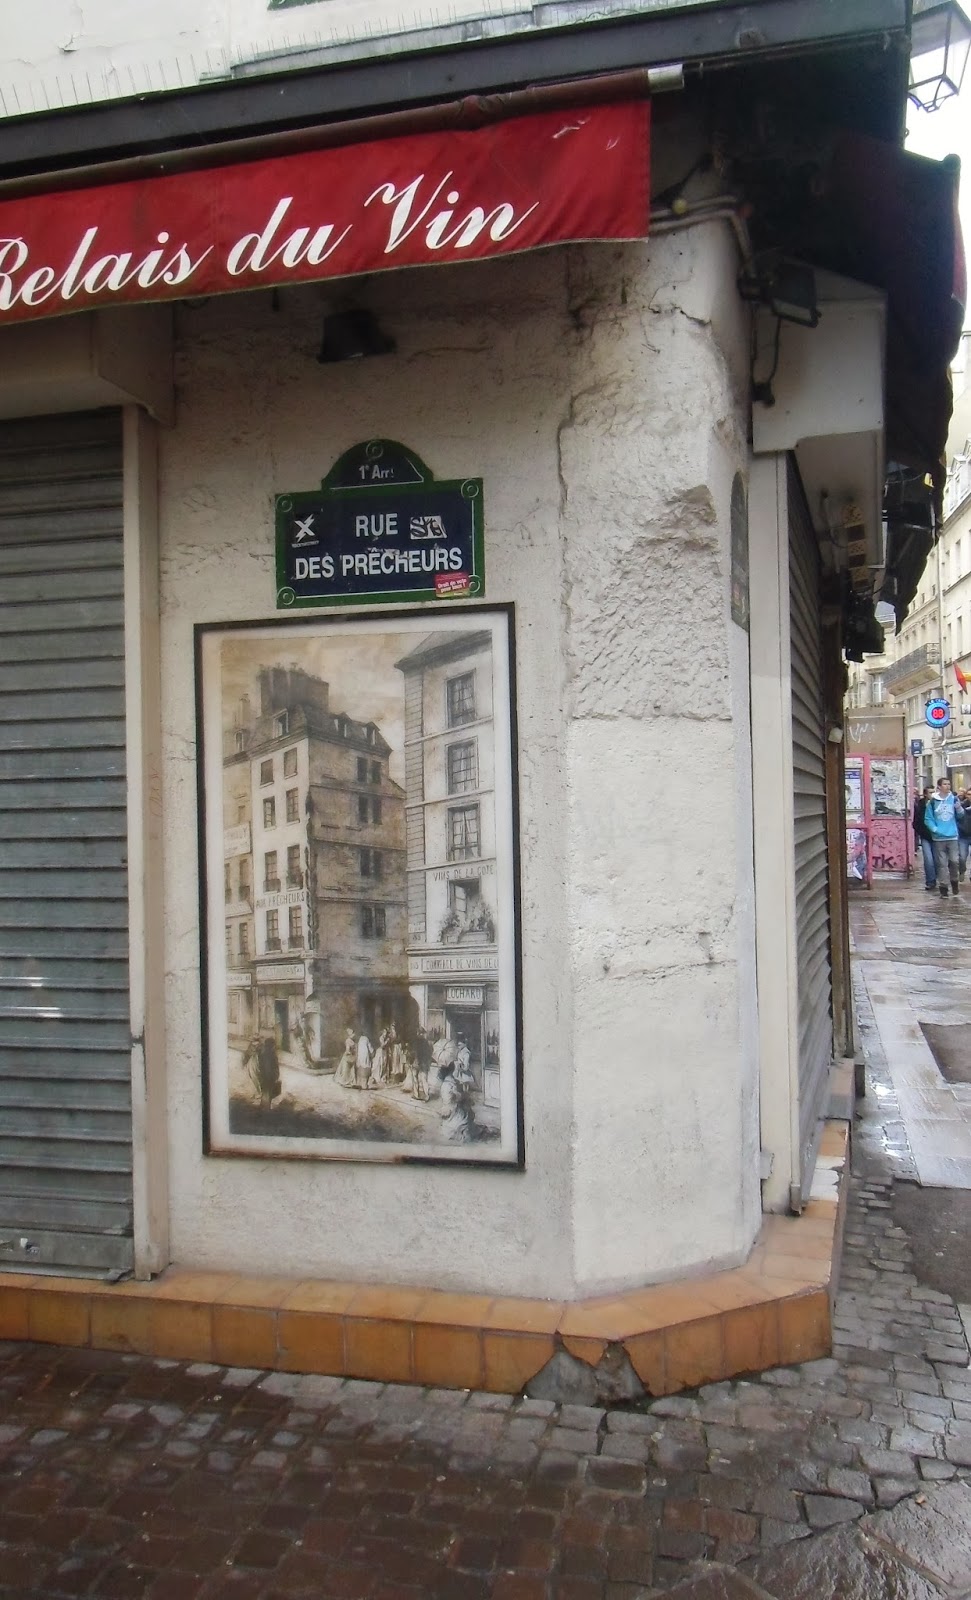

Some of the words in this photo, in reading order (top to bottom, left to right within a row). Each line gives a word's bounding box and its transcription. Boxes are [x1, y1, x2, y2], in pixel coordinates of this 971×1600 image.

[0, 227, 214, 312] Relais
[227, 196, 354, 277] du
[363, 170, 540, 256] Vin
[355, 513, 398, 537] RUE
[295, 555, 334, 580] DES
[342, 546, 463, 576] PRÊCHEURS
